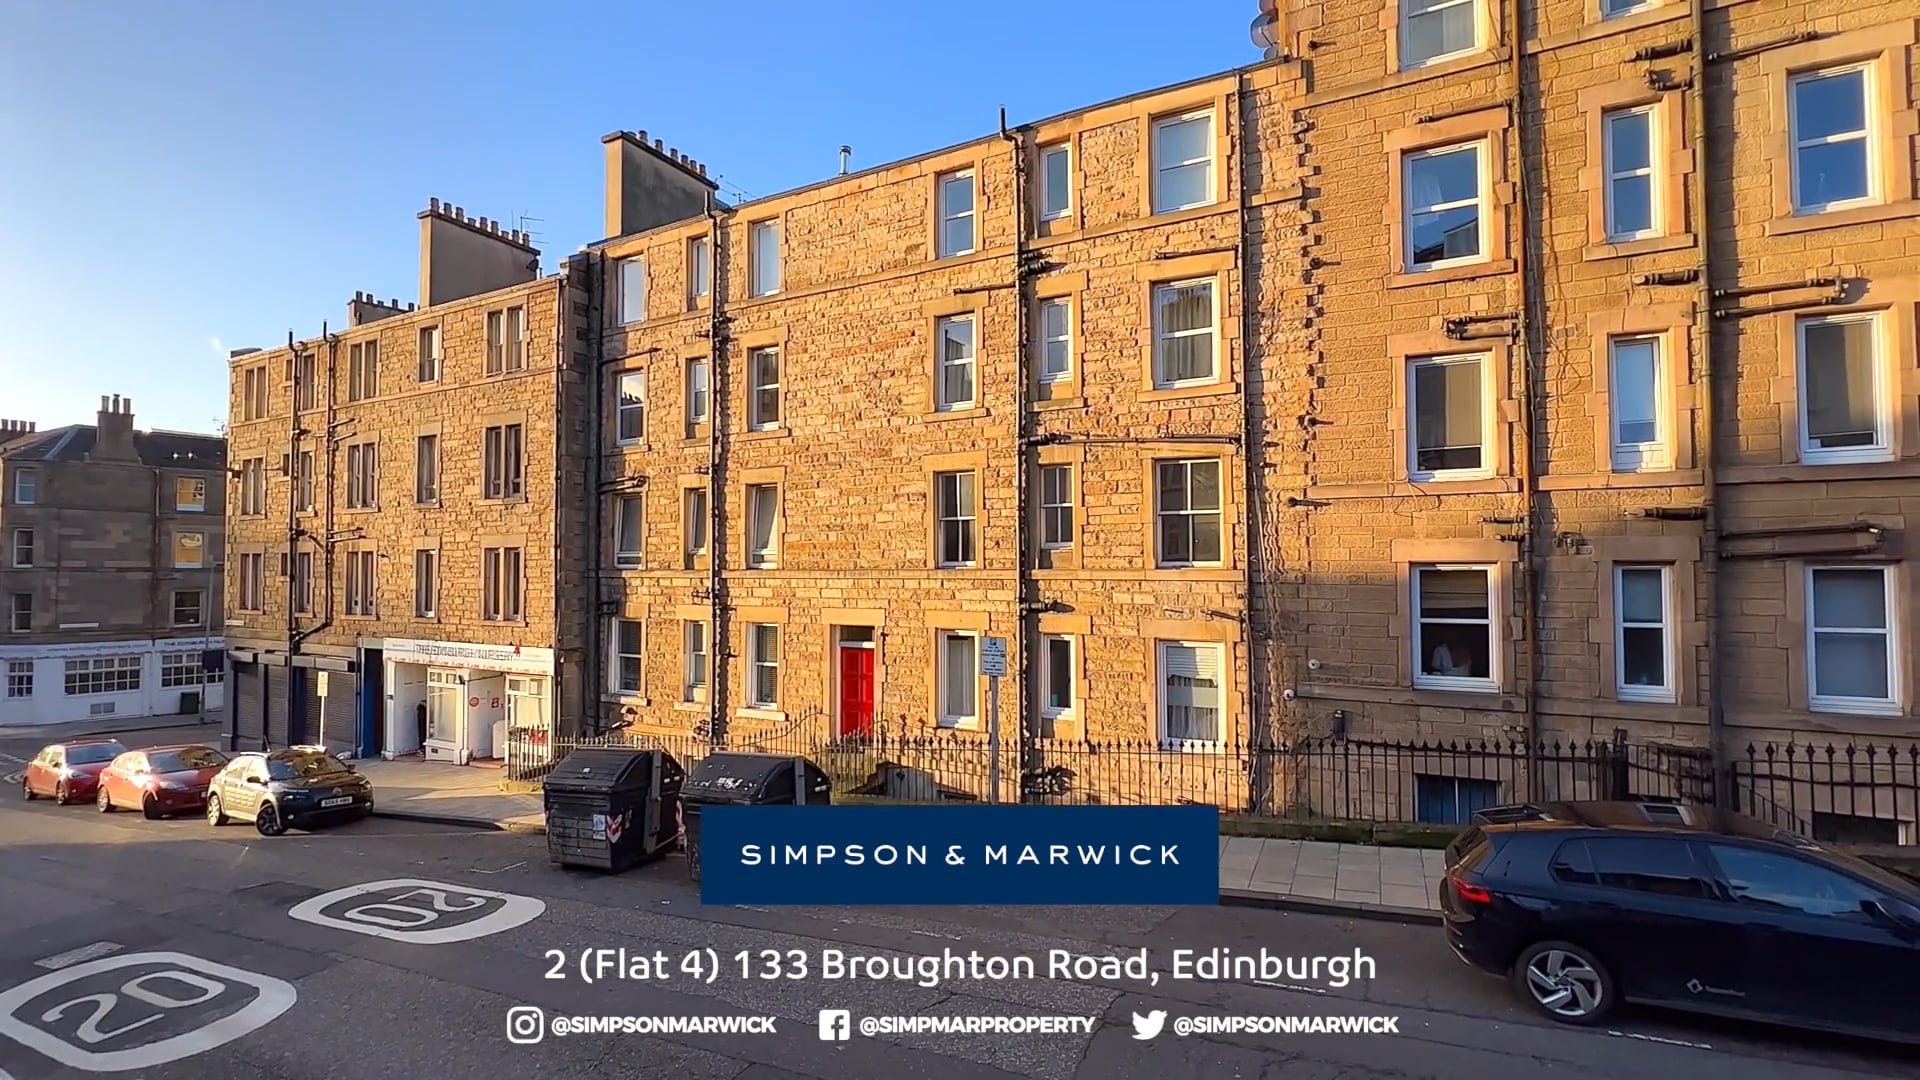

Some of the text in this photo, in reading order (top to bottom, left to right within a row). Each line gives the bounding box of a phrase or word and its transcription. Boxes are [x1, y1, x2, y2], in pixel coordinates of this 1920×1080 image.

[415, 644, 431, 655] THE
[431, 646, 475, 658] EDINBURGH
[475, 648, 512, 661] NURSERY
[344, 888, 486, 928] 20
[42, 970, 225, 1043] 20
